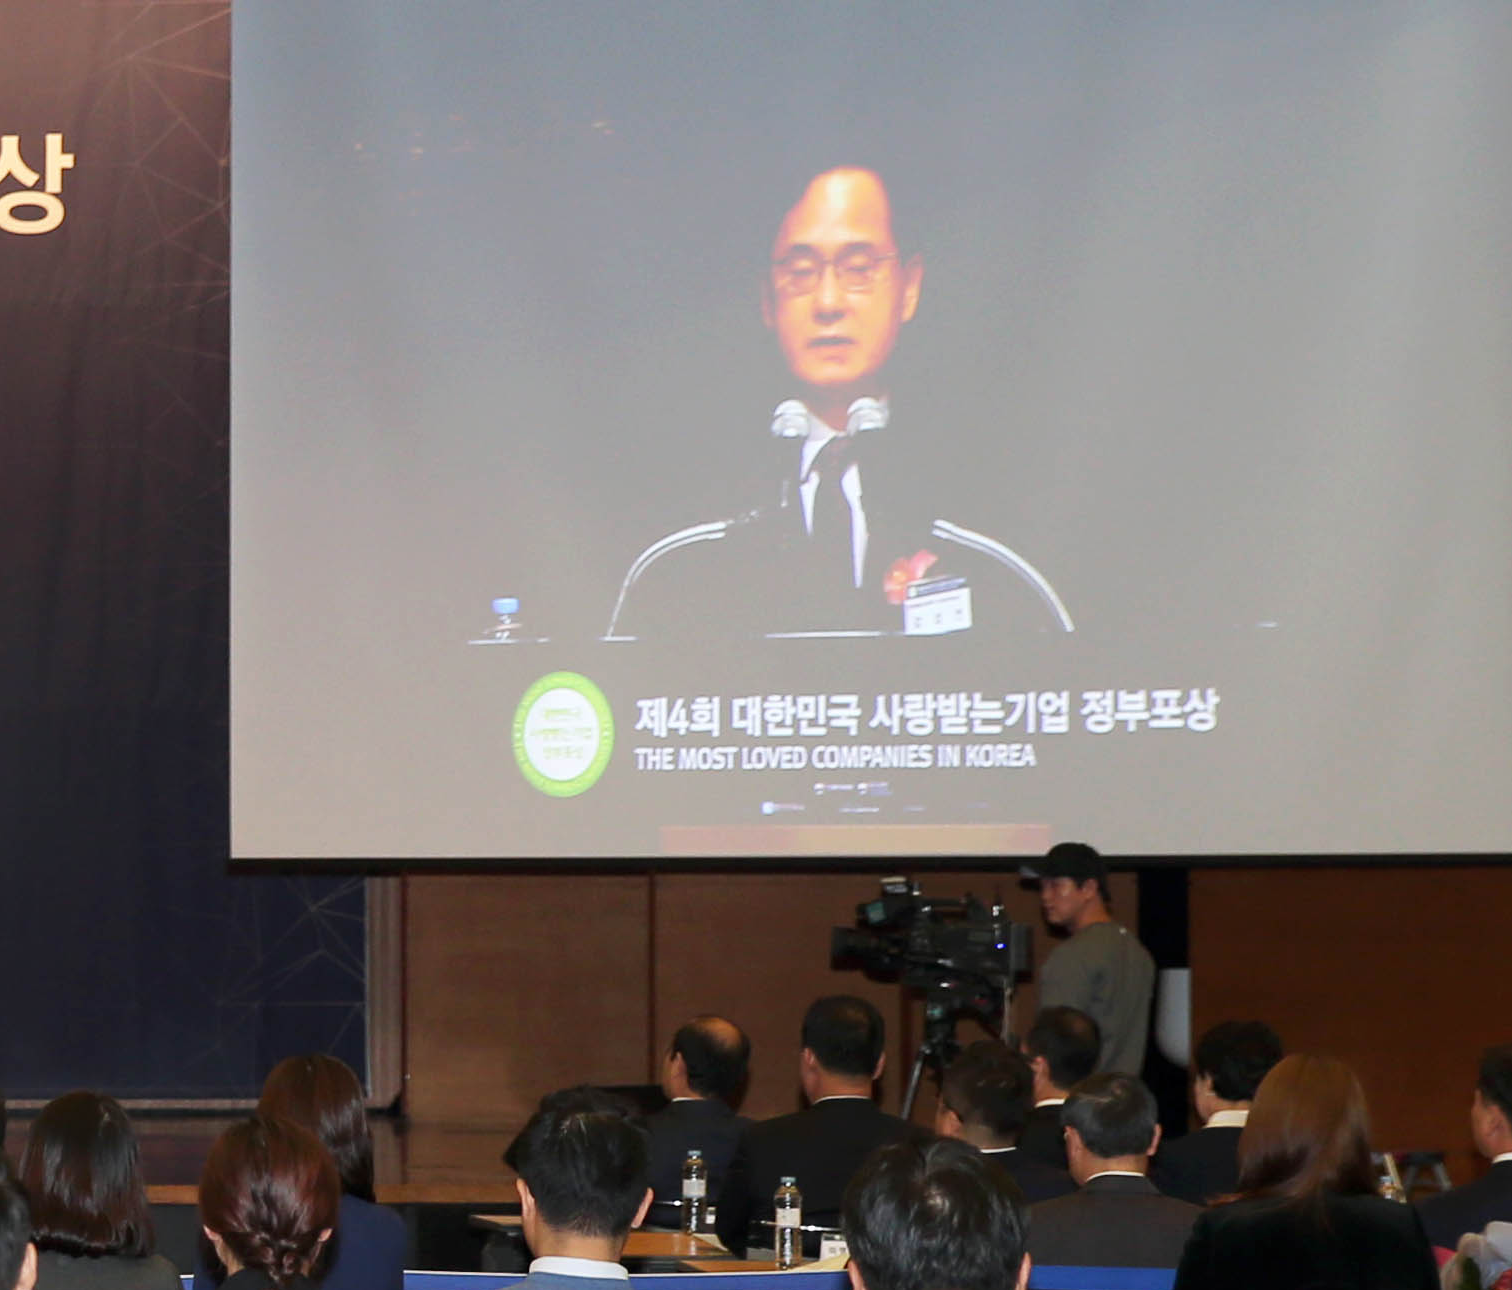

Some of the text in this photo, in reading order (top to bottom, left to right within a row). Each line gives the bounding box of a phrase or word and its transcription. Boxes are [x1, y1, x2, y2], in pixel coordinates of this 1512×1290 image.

[634, 688, 1221, 738] 제4회 대한민국 사랑받는기업 정부포상
[634, 744, 1037, 770] THE MOST LOVED COMPANIES IN KOREA
